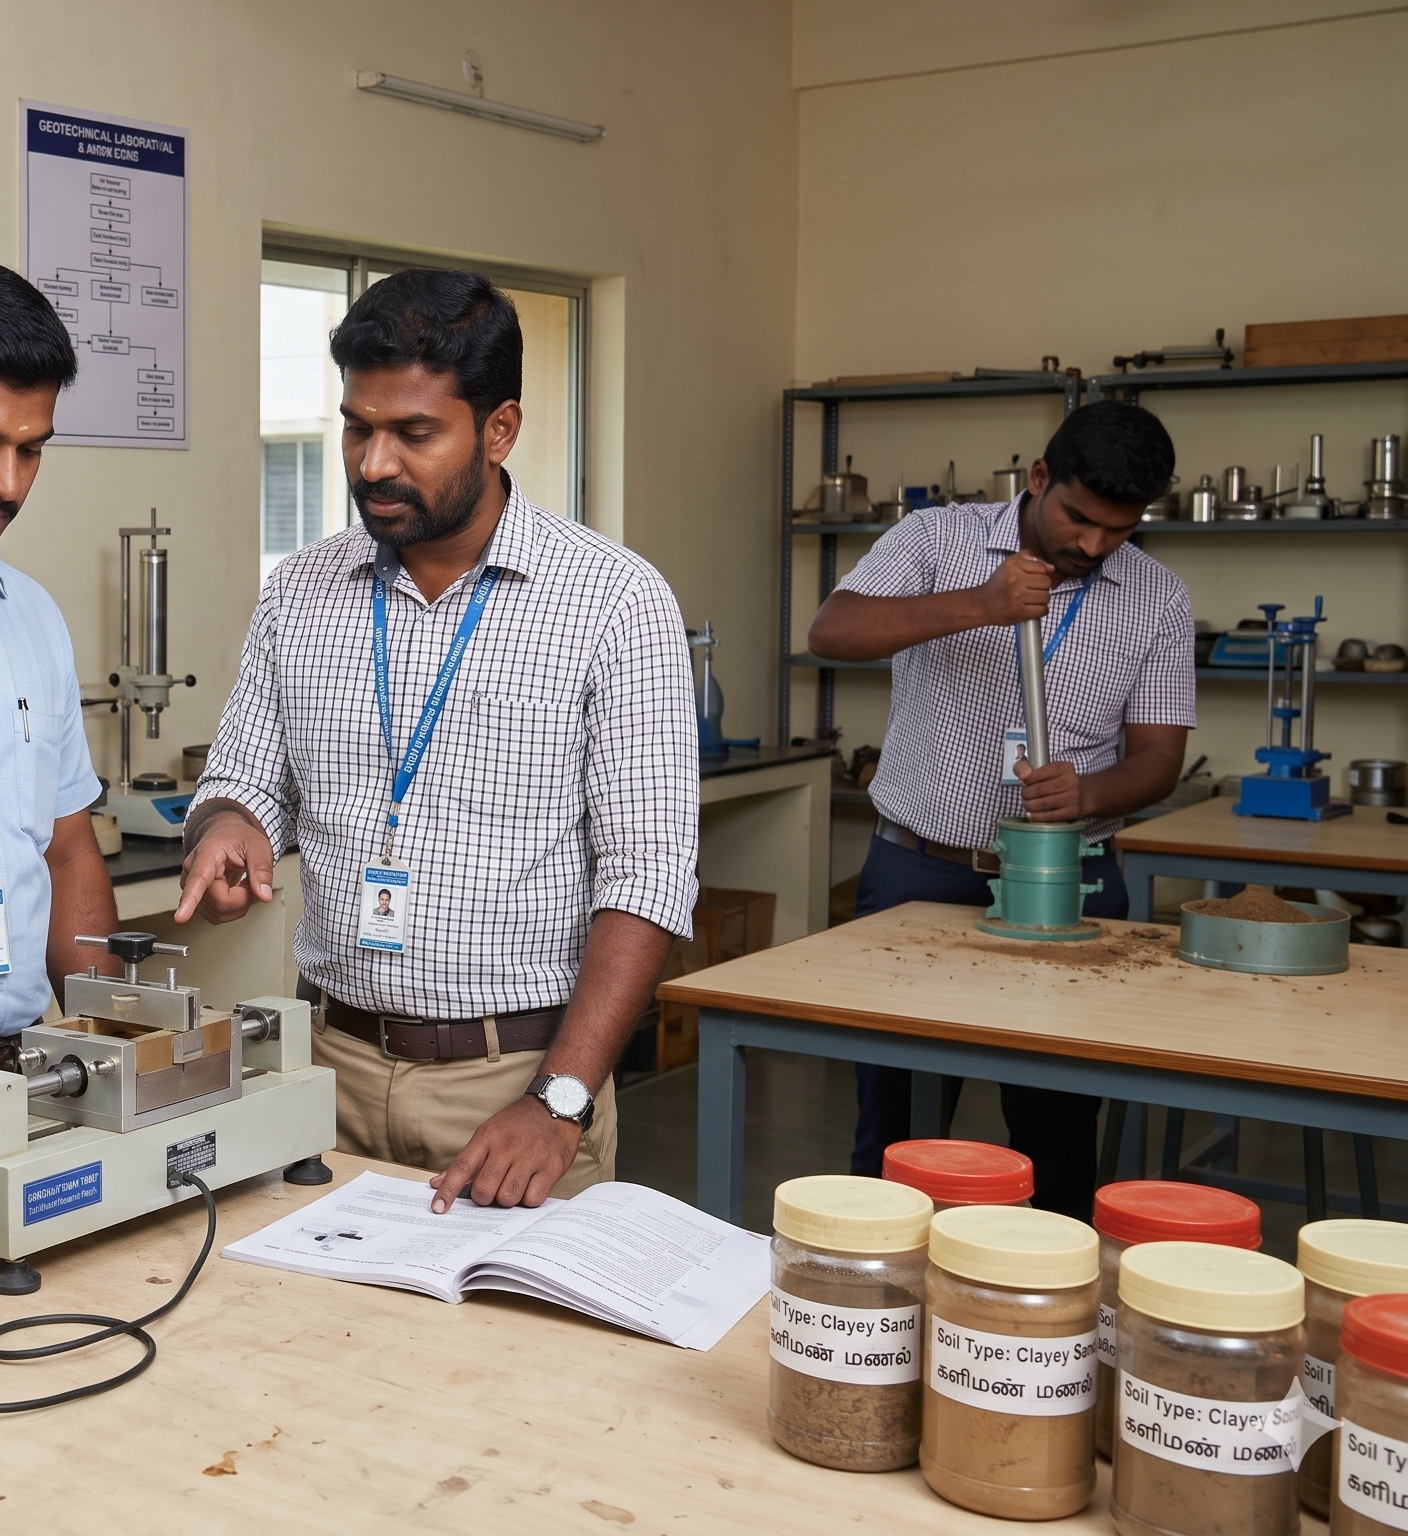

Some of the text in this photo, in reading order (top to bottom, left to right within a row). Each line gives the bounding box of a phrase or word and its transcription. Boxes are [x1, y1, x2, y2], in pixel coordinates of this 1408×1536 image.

[38, 119, 113, 143] GEOTECHNICAL
[782, 1300, 816, 1326] Type:
[821, 1314, 875, 1338] Clayey
[880, 1314, 915, 1333] Sand
[845, 1346, 912, 1367] மணல்
[937, 1327, 960, 1350] Soil
[965, 1337, 1011, 1362] Type:
[1016, 1347, 1070, 1368] Clayey
[937, 1363, 1093, 1399] களிமண் மணல்
[1304, 1360, 1324, 1383] Soil
[1124, 1379, 1149, 1406] Soil
[1153, 1393, 1202, 1421] Type:
[1208, 1408, 1268, 1432] Clayey
[1125, 1416, 1221, 1459] களிமண்
[1347, 1433, 1378, 1461] Soil
